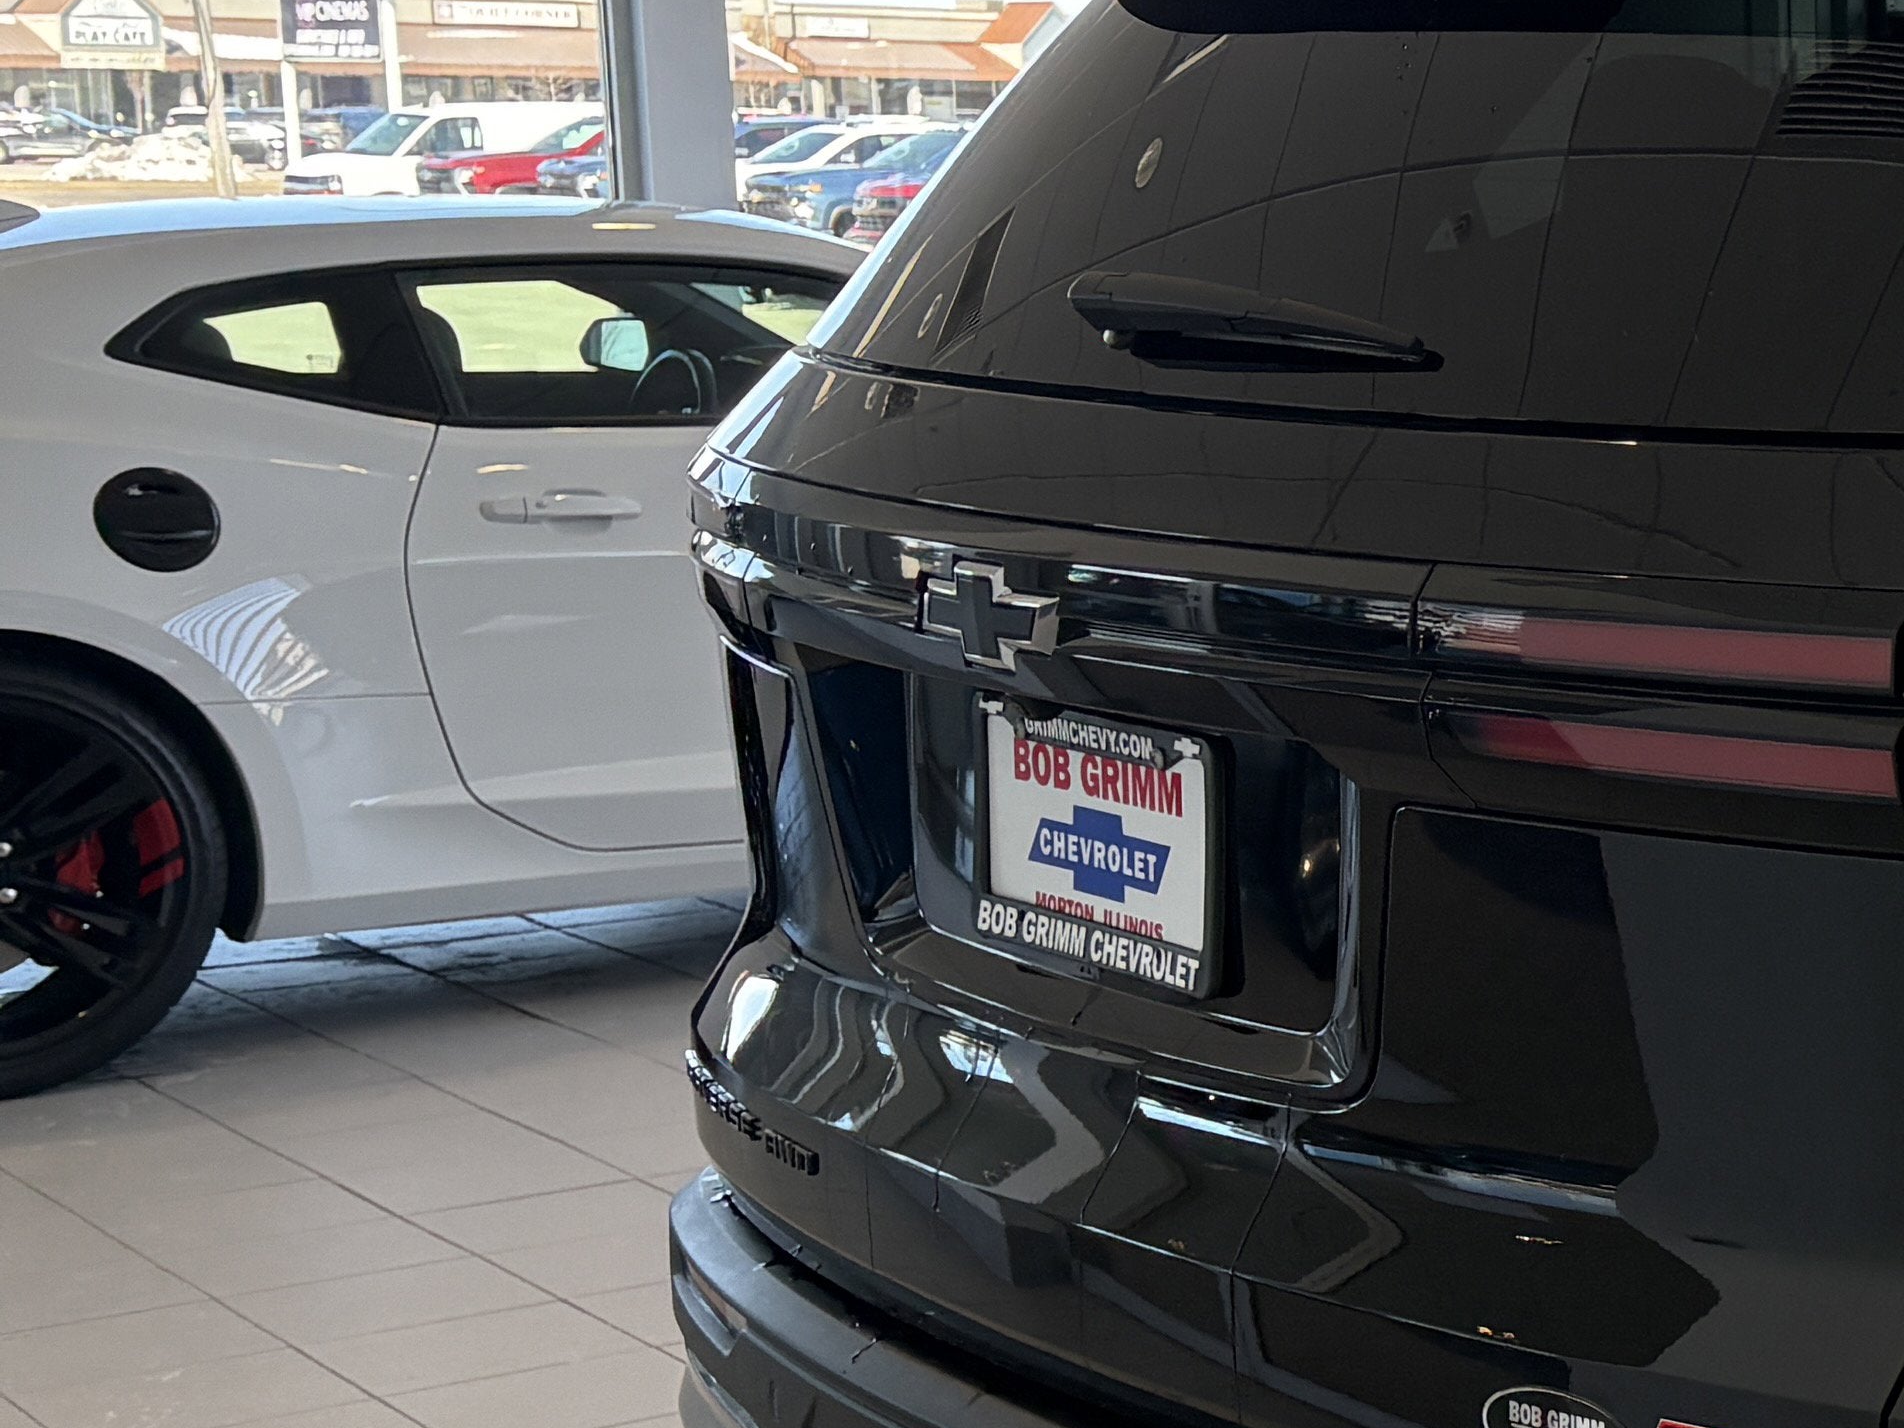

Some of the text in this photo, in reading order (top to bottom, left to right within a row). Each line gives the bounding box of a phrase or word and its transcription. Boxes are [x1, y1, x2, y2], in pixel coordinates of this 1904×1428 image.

[1014, 739, 1183, 817] BOB GRIMM
[1040, 828, 1157, 882] CHEVROLET
[977, 900, 1199, 991] BOB GRIMM CHEVROLET
[1508, 1400, 1543, 1428] BOB
